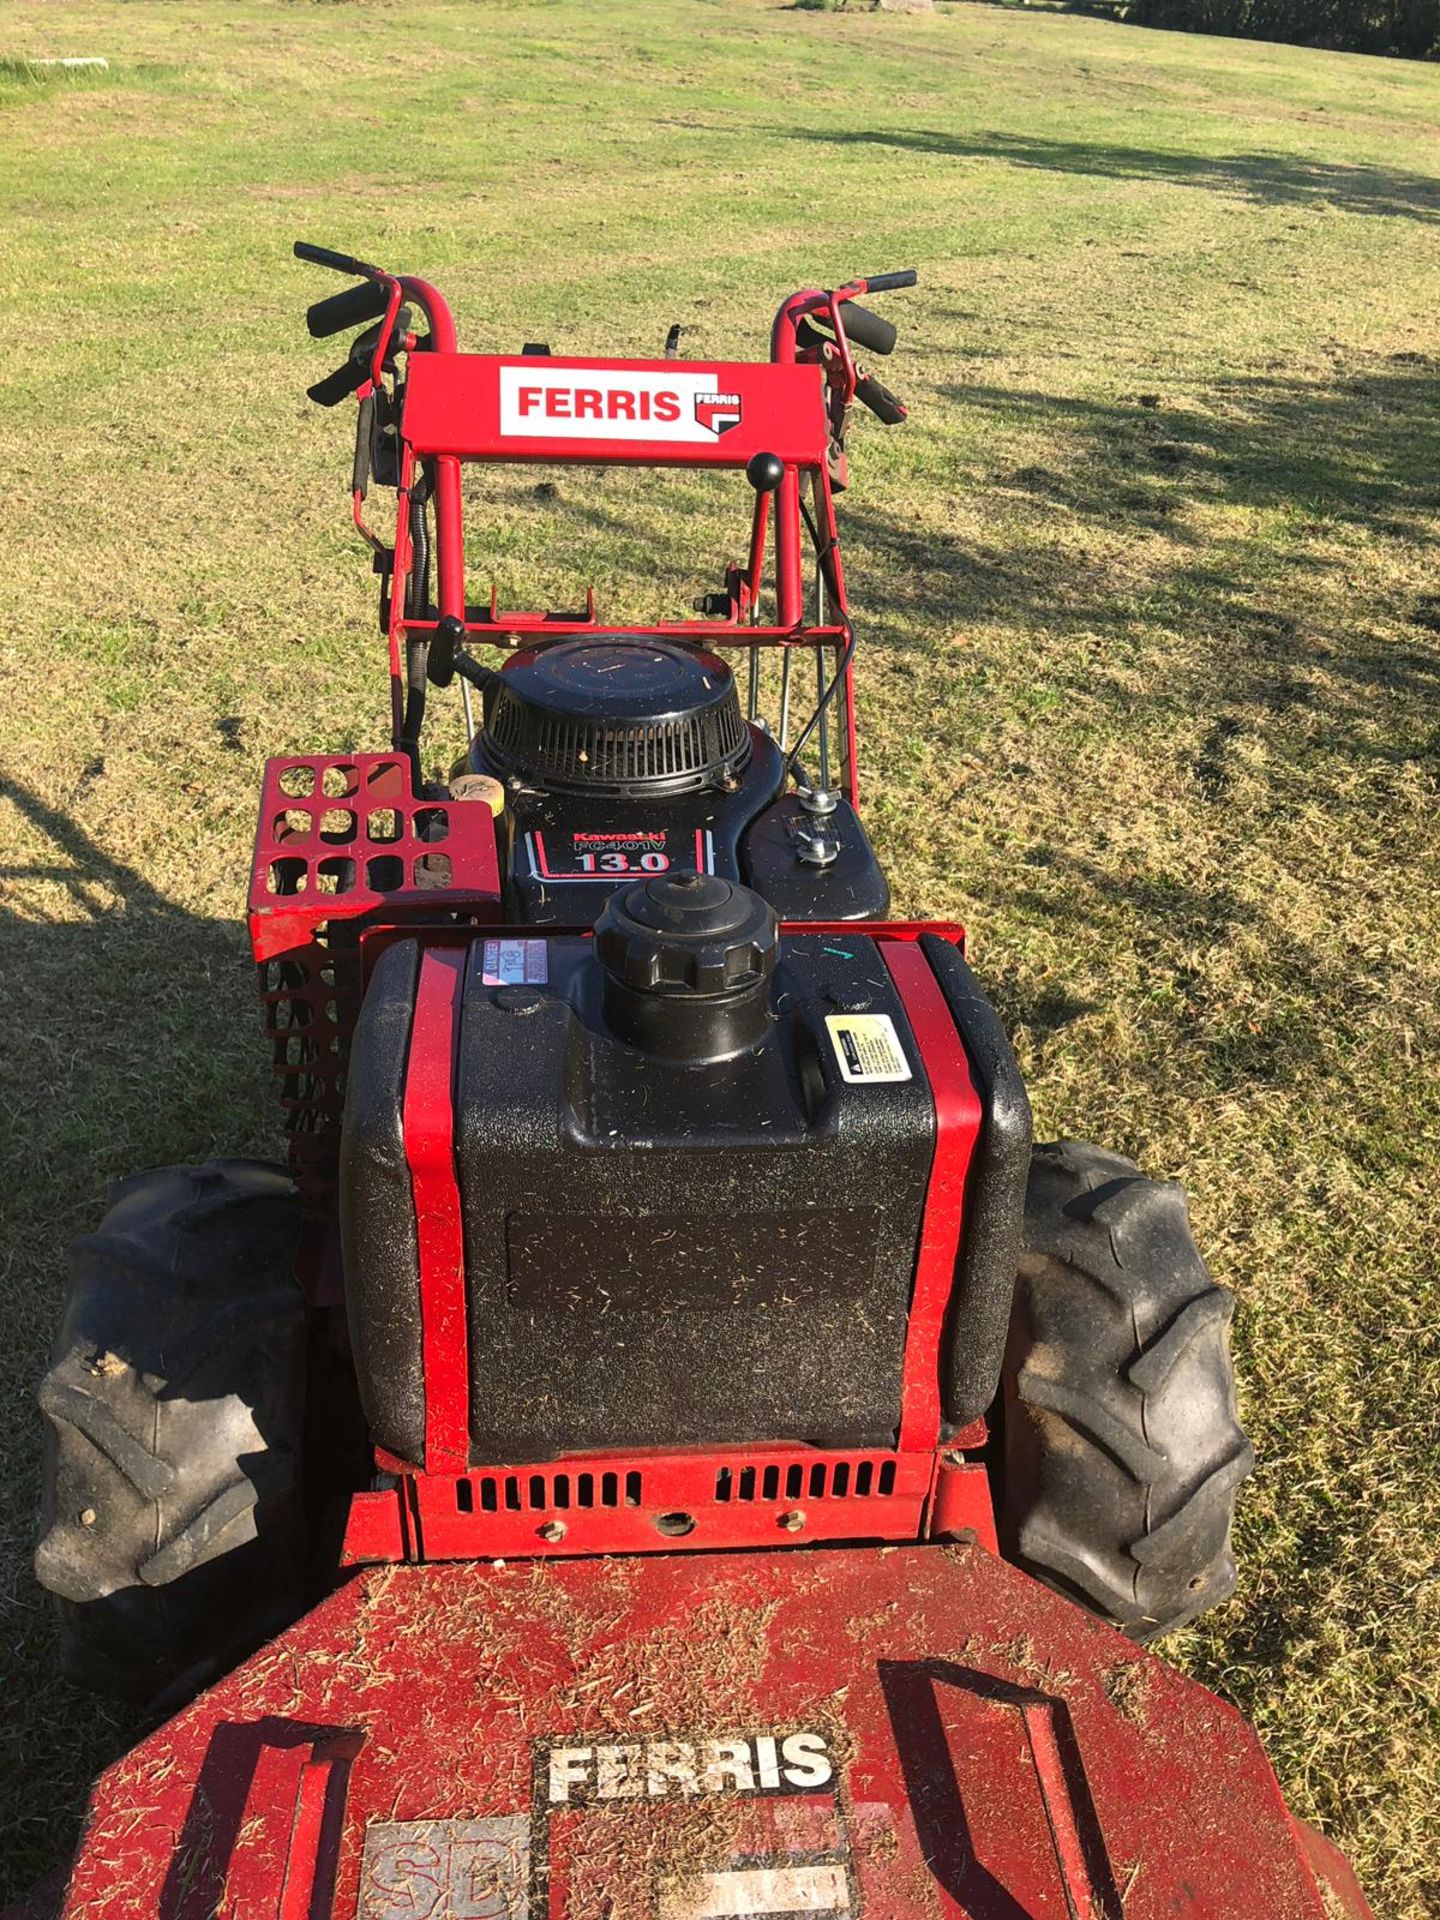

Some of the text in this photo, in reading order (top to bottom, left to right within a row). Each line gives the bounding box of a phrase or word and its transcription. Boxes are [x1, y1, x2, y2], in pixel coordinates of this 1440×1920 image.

[518, 387, 681, 421] FERRIS
[696, 394, 740, 404] FERRIS
[574, 841, 666, 852] FC401V
[574, 853, 670, 872] 13.0
[549, 1733, 832, 1801] FERRIS
